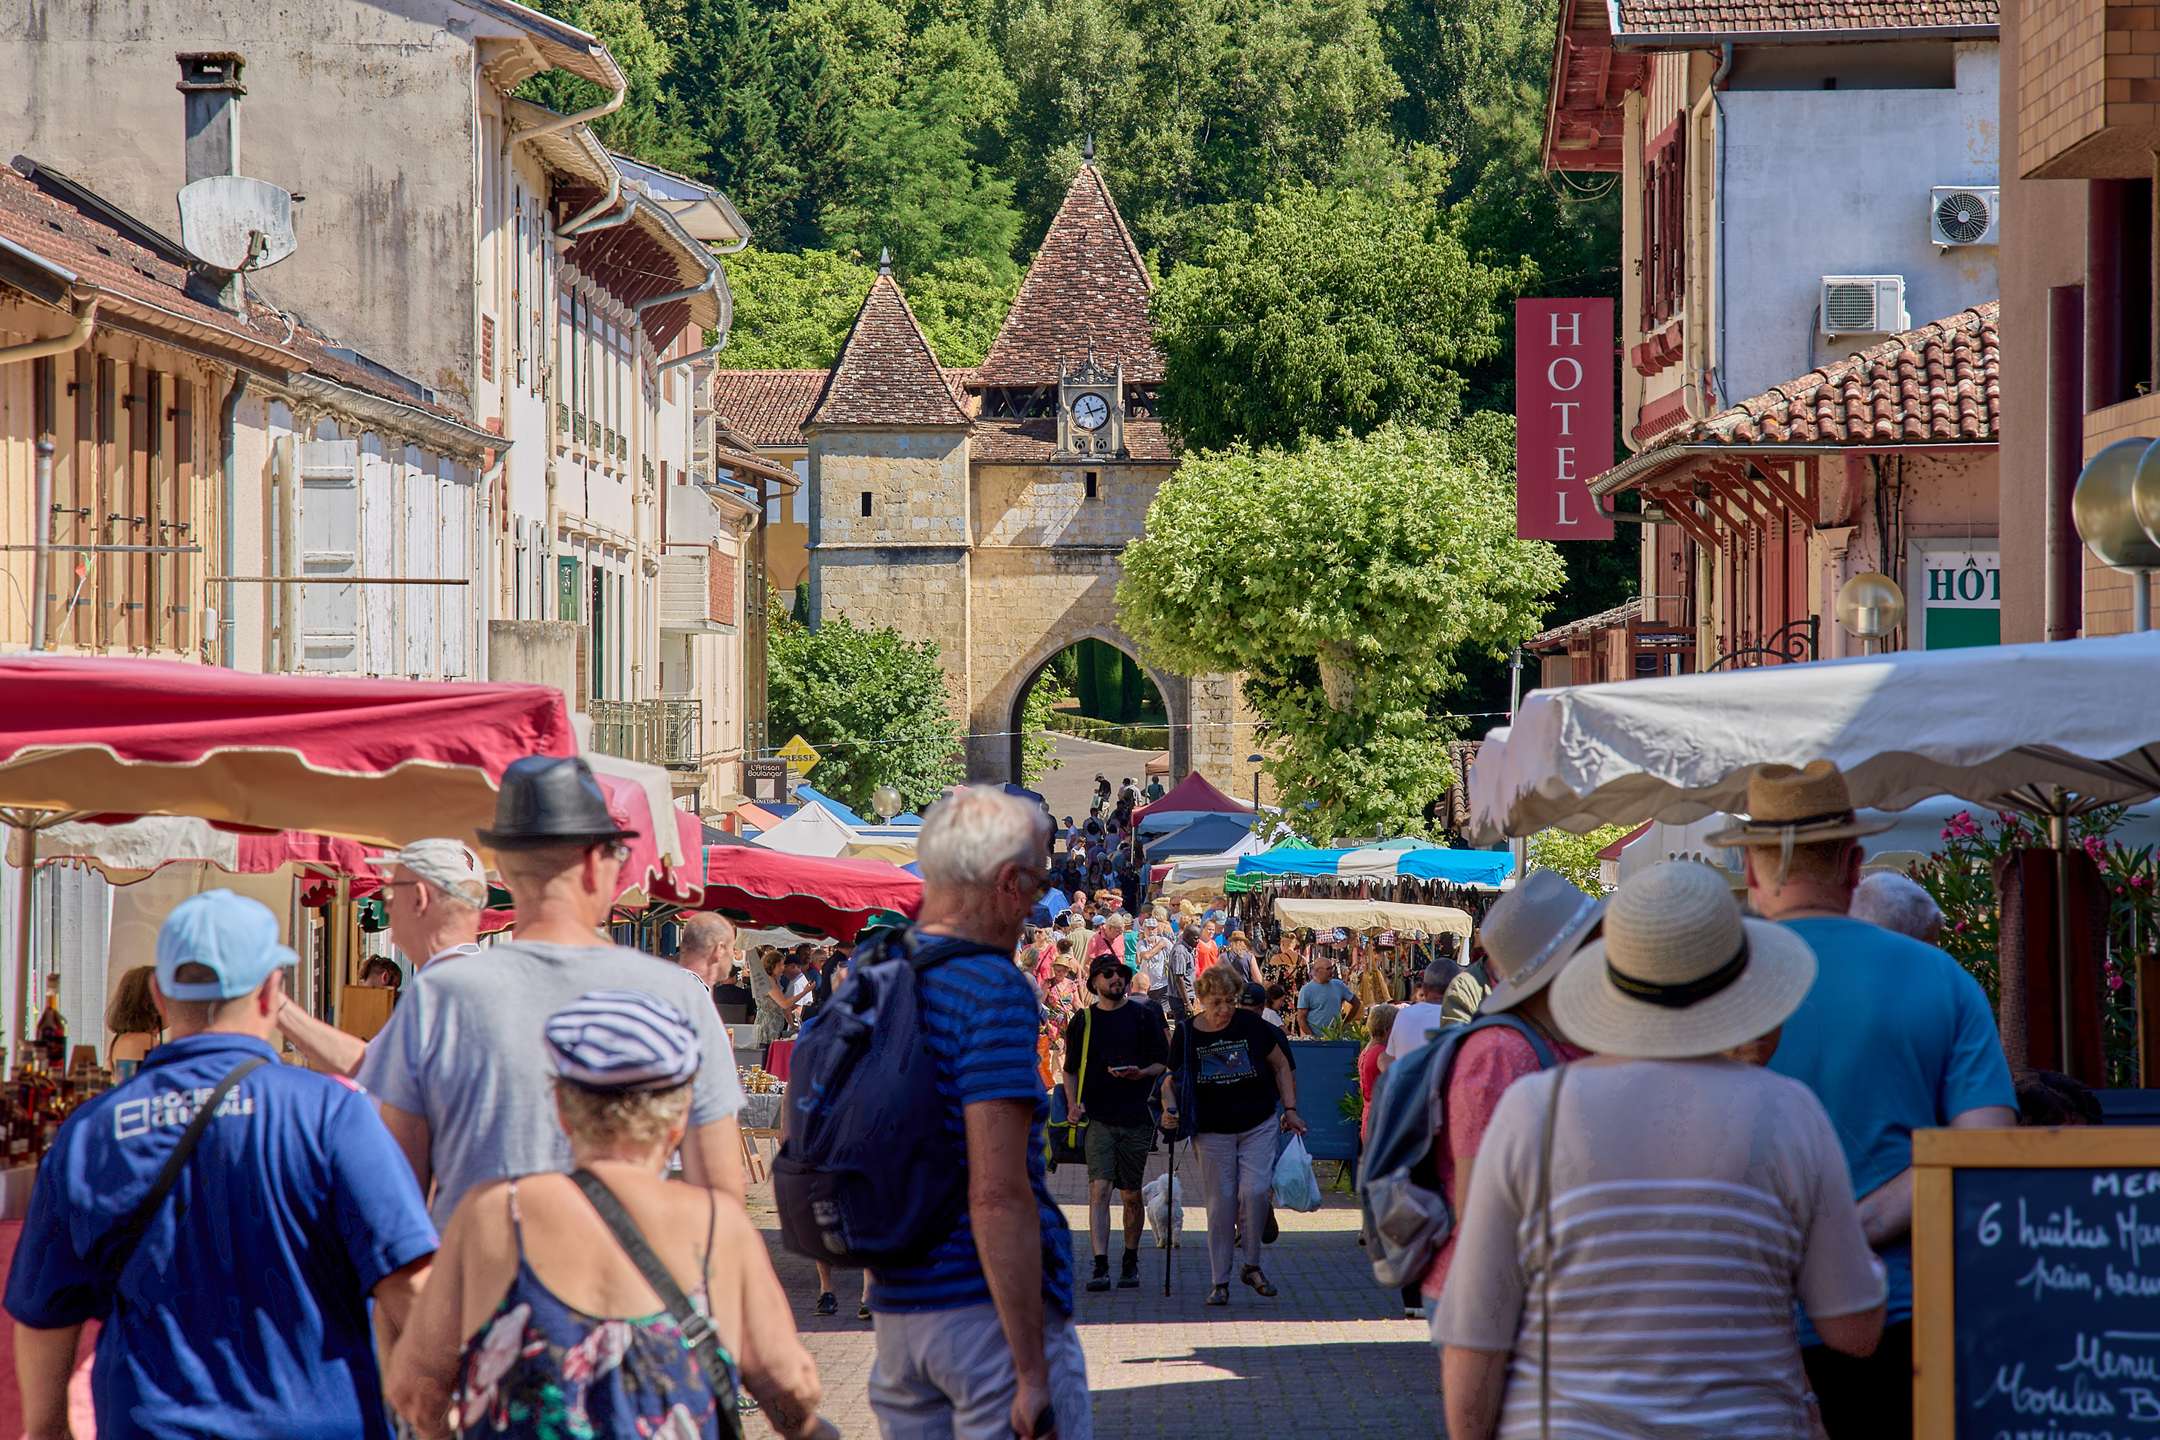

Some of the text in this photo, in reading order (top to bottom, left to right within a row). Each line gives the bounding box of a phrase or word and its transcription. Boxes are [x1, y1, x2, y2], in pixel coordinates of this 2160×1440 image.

[1547, 312, 1583, 525] HOTEL
[747, 769, 783, 778] Boulanger
[1978, 1201, 2002, 1246] 6
